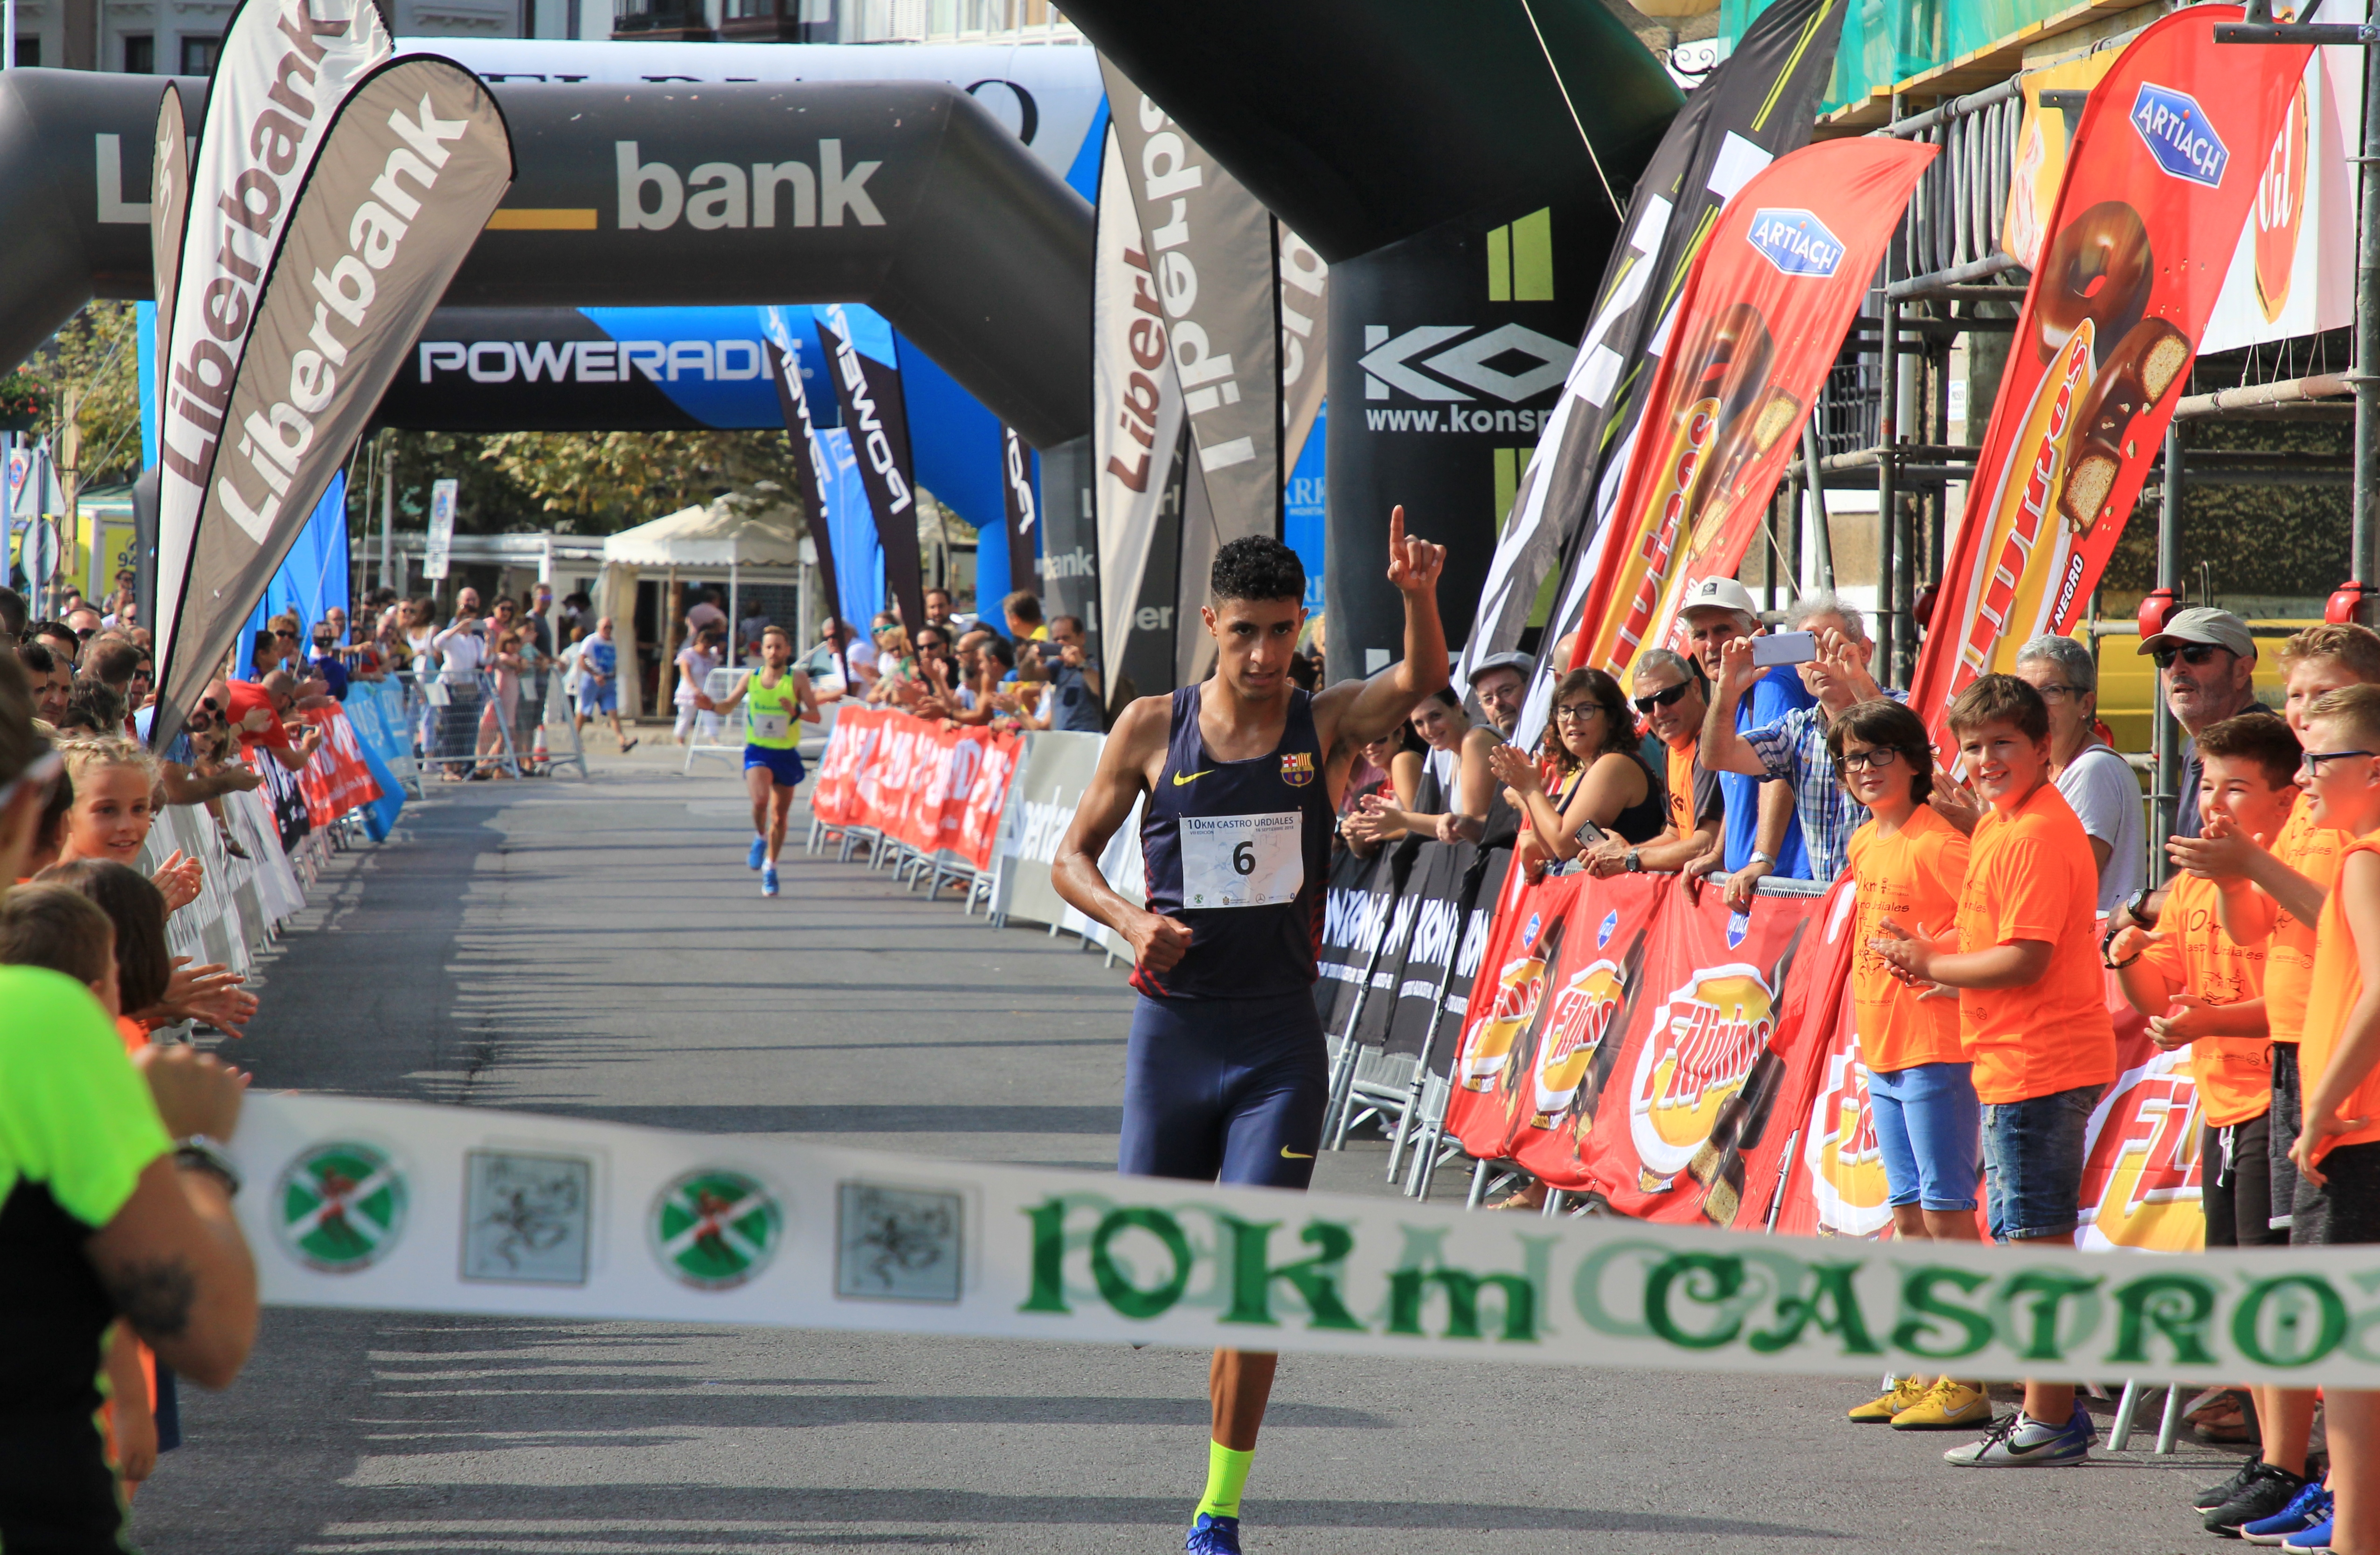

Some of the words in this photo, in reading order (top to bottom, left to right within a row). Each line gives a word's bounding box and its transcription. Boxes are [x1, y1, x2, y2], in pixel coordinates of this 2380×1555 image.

[2138, 96, 2221, 178] ARTIACH
[615, 139, 886, 229] bank
[161, 0, 351, 488] Liberbank
[1755, 218, 1838, 270] ARTIACH
[218, 92, 468, 546] Liberbank
[2054, 554, 2084, 628] NEGRO
[766, 721, 773, 729] 4
[1188, 819, 1215, 830] 10KM
[1217, 819, 1252, 829] CASTRO
[1254, 817, 1294, 827] URDIALES
[1232, 840, 1256, 875] 6
[1634, 997, 1772, 1114] Filipinos
[1644, 1250, 2349, 1370] CASTRO
